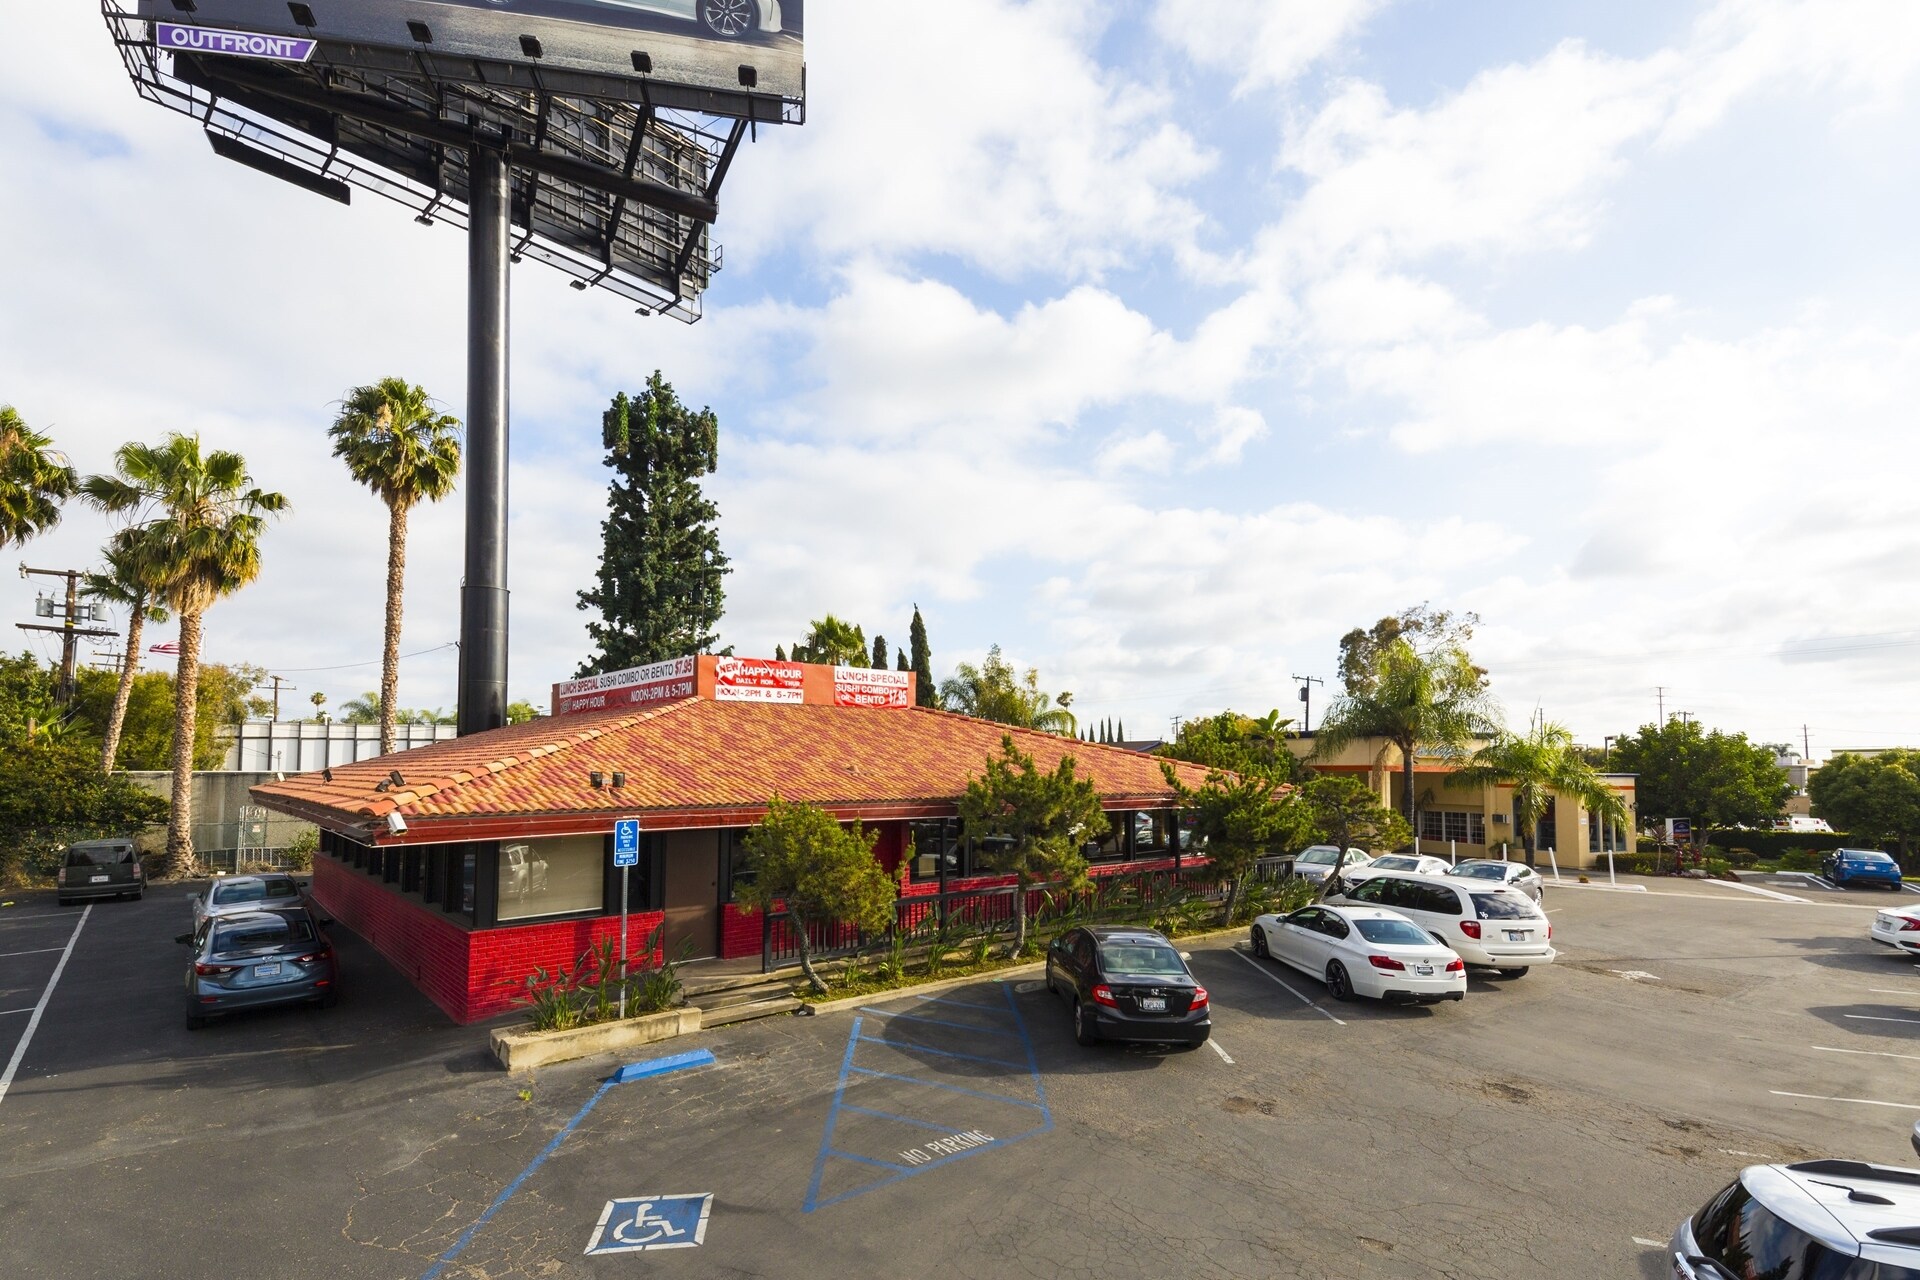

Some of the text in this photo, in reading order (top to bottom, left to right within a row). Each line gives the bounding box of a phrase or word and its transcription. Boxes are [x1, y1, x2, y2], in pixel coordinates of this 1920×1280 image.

[171, 28, 298, 57] OUTFRONT
[719, 662, 738, 673] NEW
[741, 666, 803, 679] HAPPY HOUR
[561, 659, 693, 696] LUNCH SPECIAL SUSHI COMBO OR BENTO $7.95
[836, 670, 907, 685] LUNCH SPECIAL
[665, 687, 670, 697] &
[671, 682, 692, 697] 5-7PM
[765, 690, 772, 698] &
[776, 690, 802, 700] 5-7PM
[835, 683, 889, 695] SUSHI COMBO
[572, 697, 590, 710] HAPPY
[590, 696, 605, 708] HOUR
[855, 694, 885, 705] BENTO
[898, 1129, 995, 1166] NO PARKING
